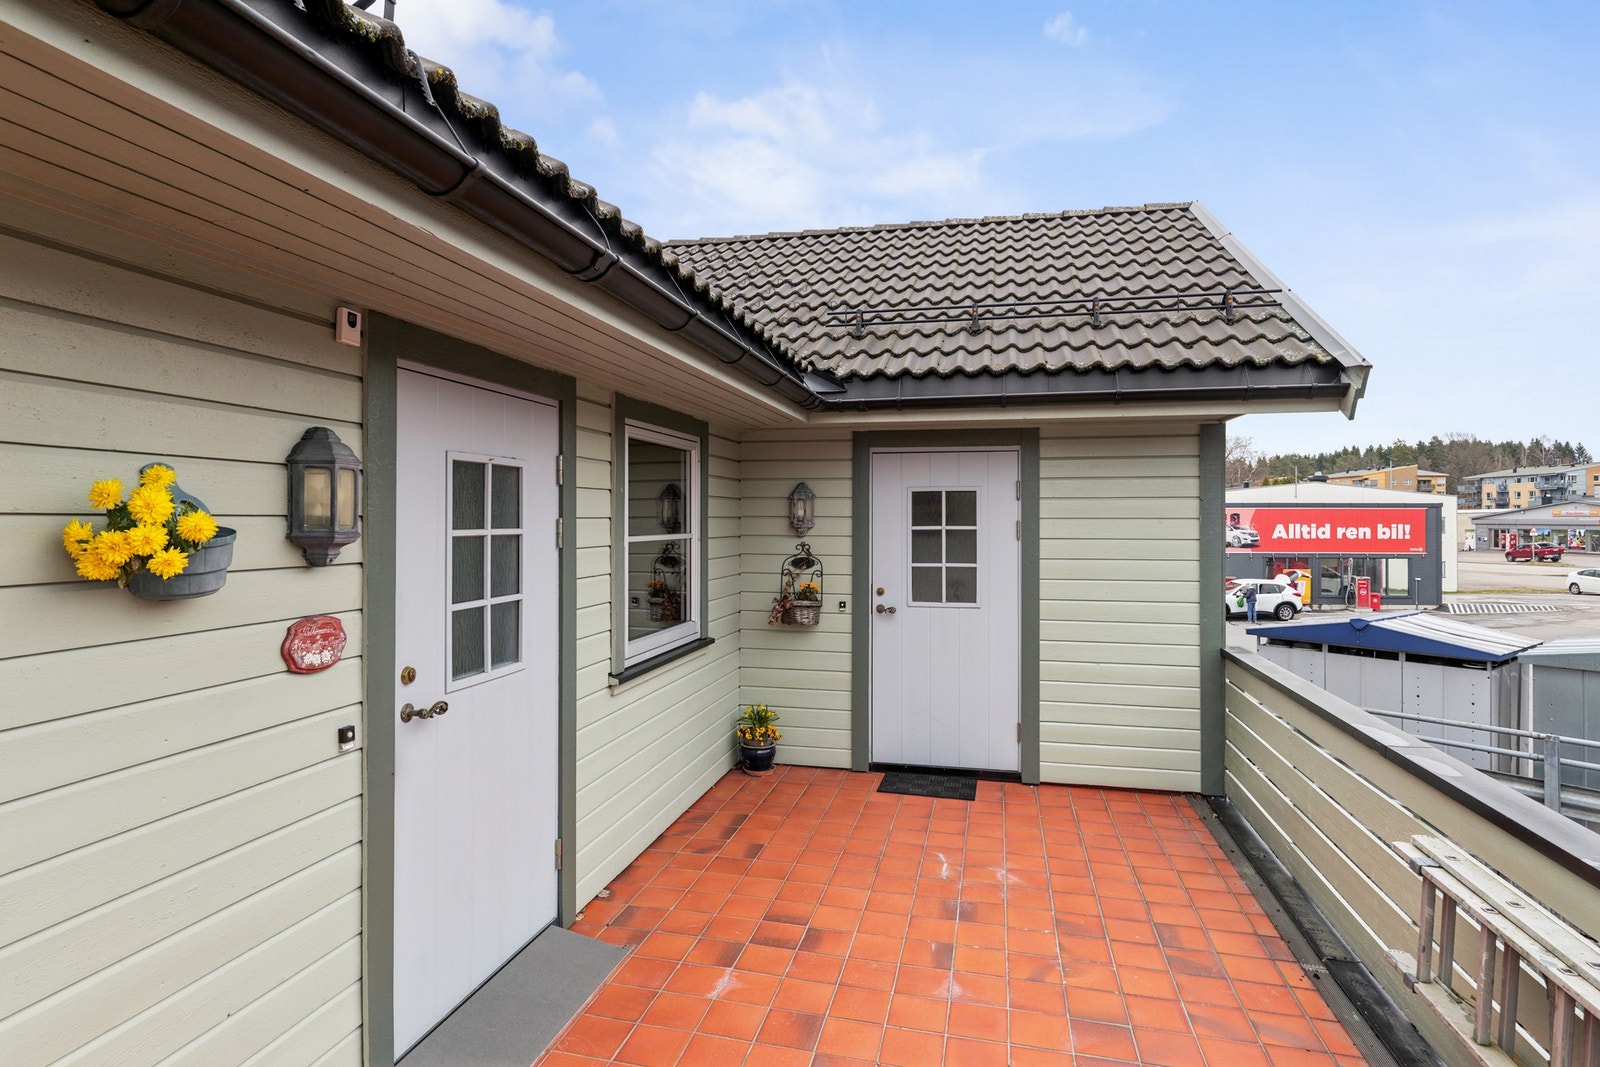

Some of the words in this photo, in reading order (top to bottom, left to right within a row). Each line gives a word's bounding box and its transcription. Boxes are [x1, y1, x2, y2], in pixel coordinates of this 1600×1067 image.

[1271, 523, 1331, 539] Alltid
[1336, 526, 1371, 539] ren
[1377, 523, 1411, 539] bil!
